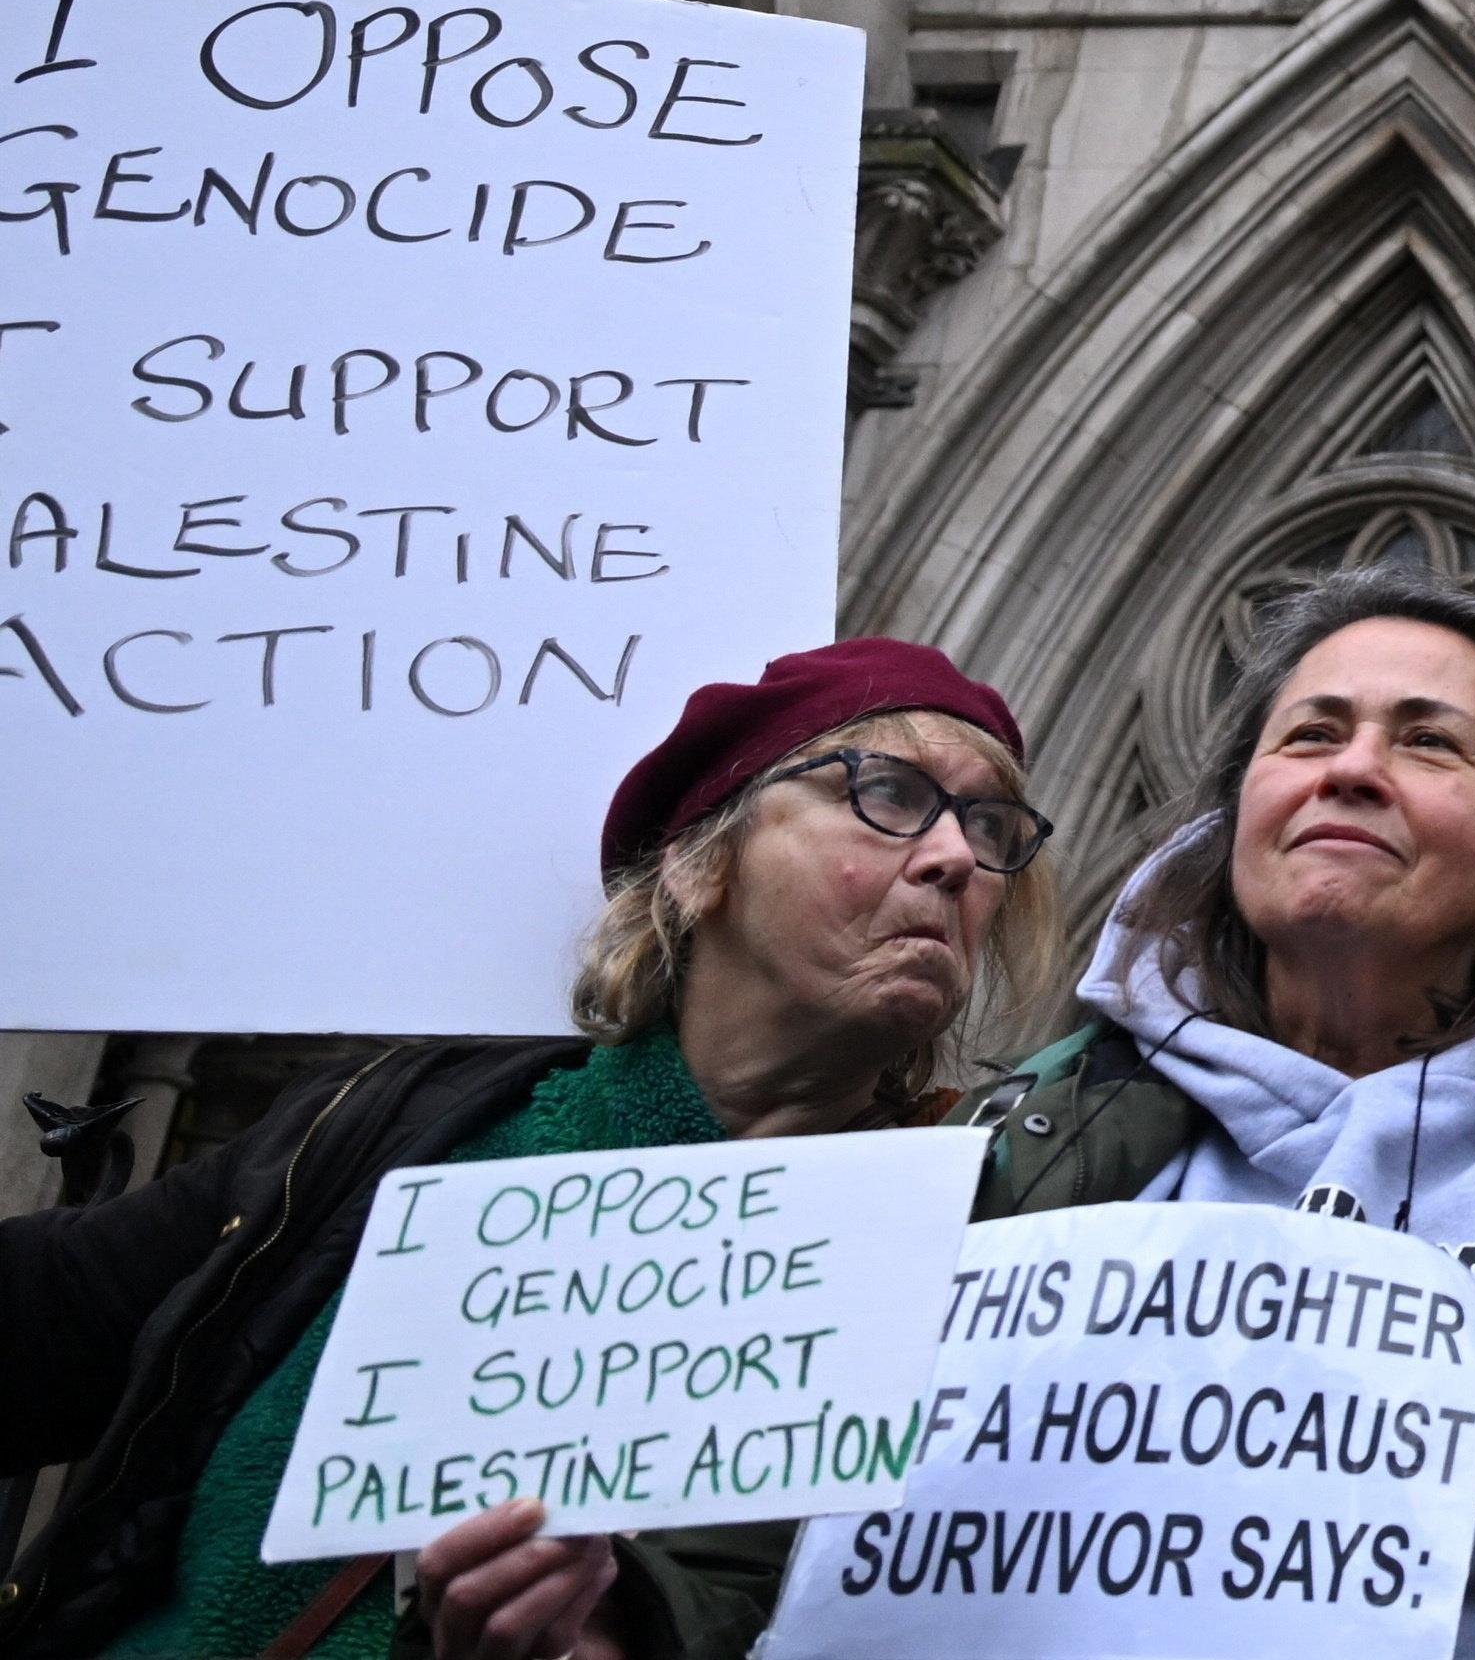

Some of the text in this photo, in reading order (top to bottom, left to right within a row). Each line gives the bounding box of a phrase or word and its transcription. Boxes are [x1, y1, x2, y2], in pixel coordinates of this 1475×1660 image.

[200, 1, 764, 147] OPPOSE
[130, 334, 751, 446] SUPPORT
[8, 493, 671, 583] ALESTINE
[377, 1166, 788, 1257] I OPPOSE
[939, 1258, 1466, 1365] THIS DAUGHTER
[344, 1328, 838, 1426] I SUPPORT
[914, 1382, 1475, 1485] F A HOLOCAUST
[841, 1510, 1432, 1609] SURVIVOR SAYS:
